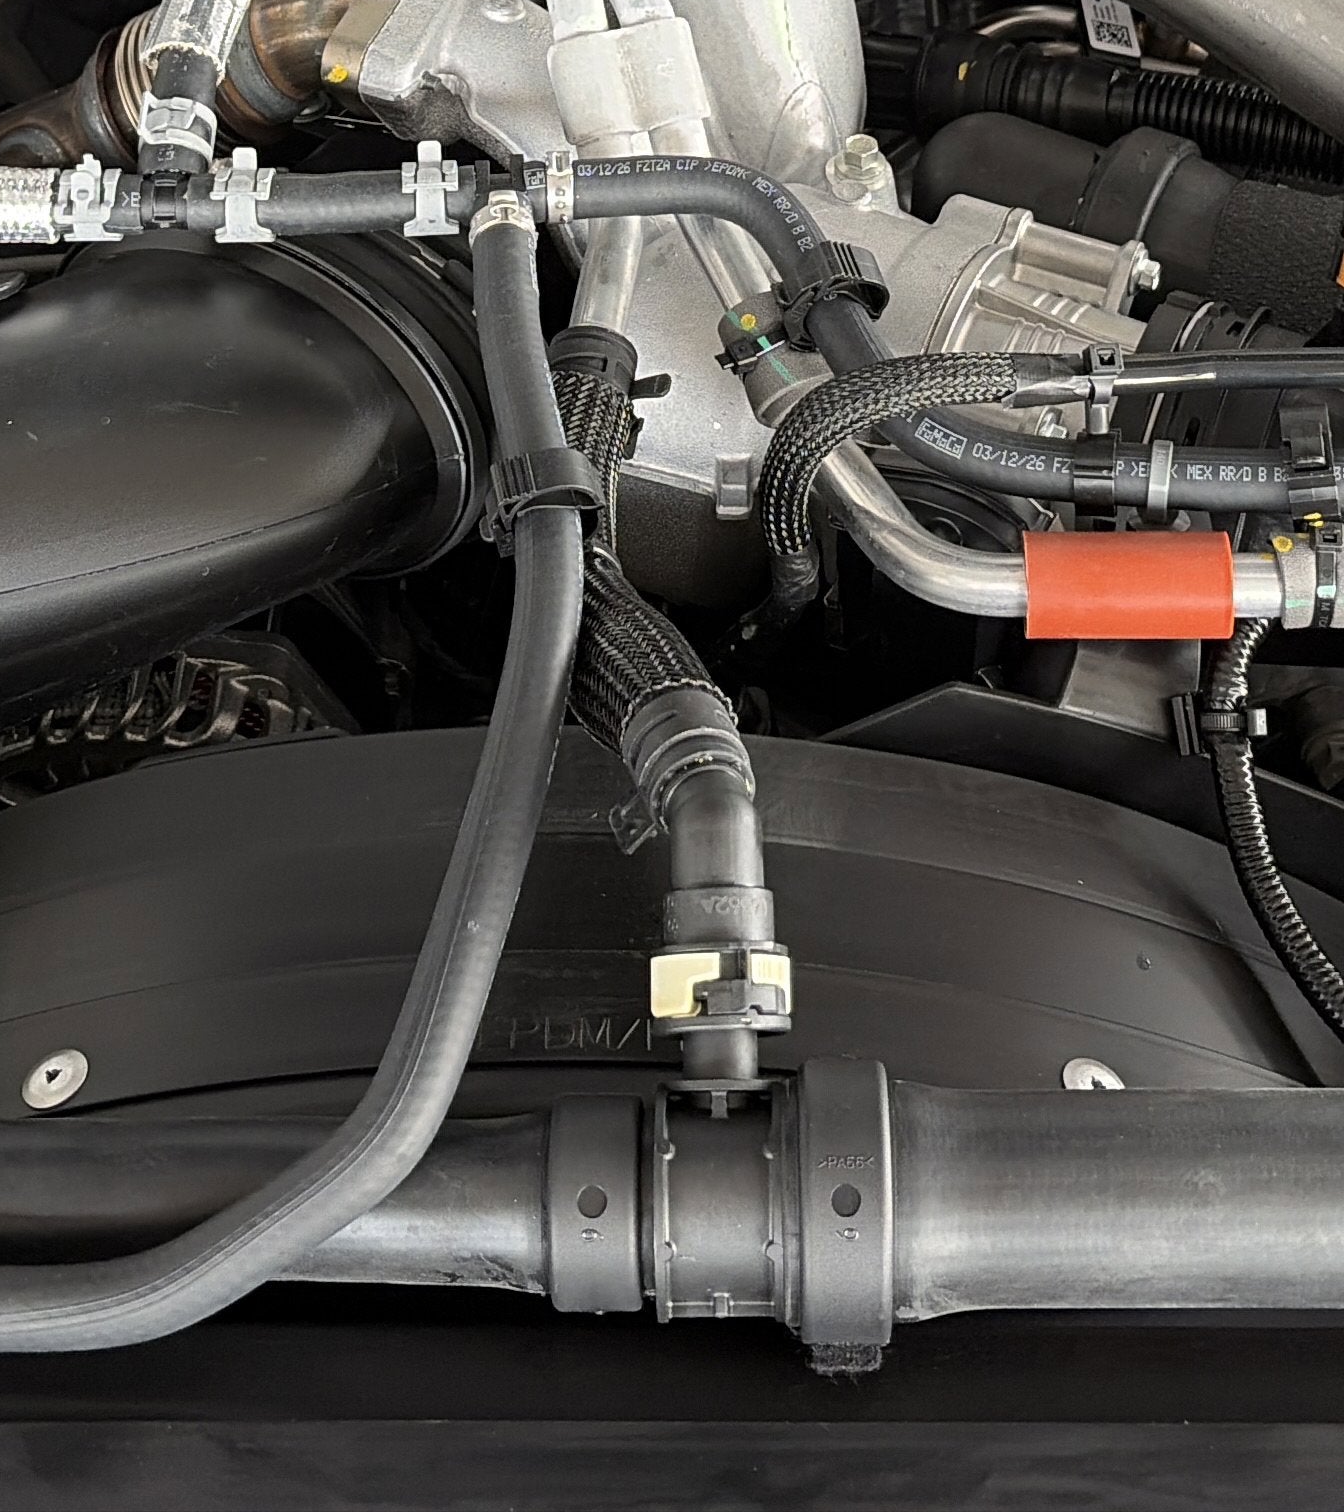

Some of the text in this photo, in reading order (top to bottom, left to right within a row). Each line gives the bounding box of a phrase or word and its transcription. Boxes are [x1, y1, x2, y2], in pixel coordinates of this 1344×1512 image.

[752, 176, 778, 197] MEX
[916, 419, 967, 459] FoMoCo
[972, 443, 1046, 472] 03/12/26
[1187, 463, 1213, 481] MEX
[1219, 465, 1252, 482] RR/D
[1258, 466, 1267, 482] B
